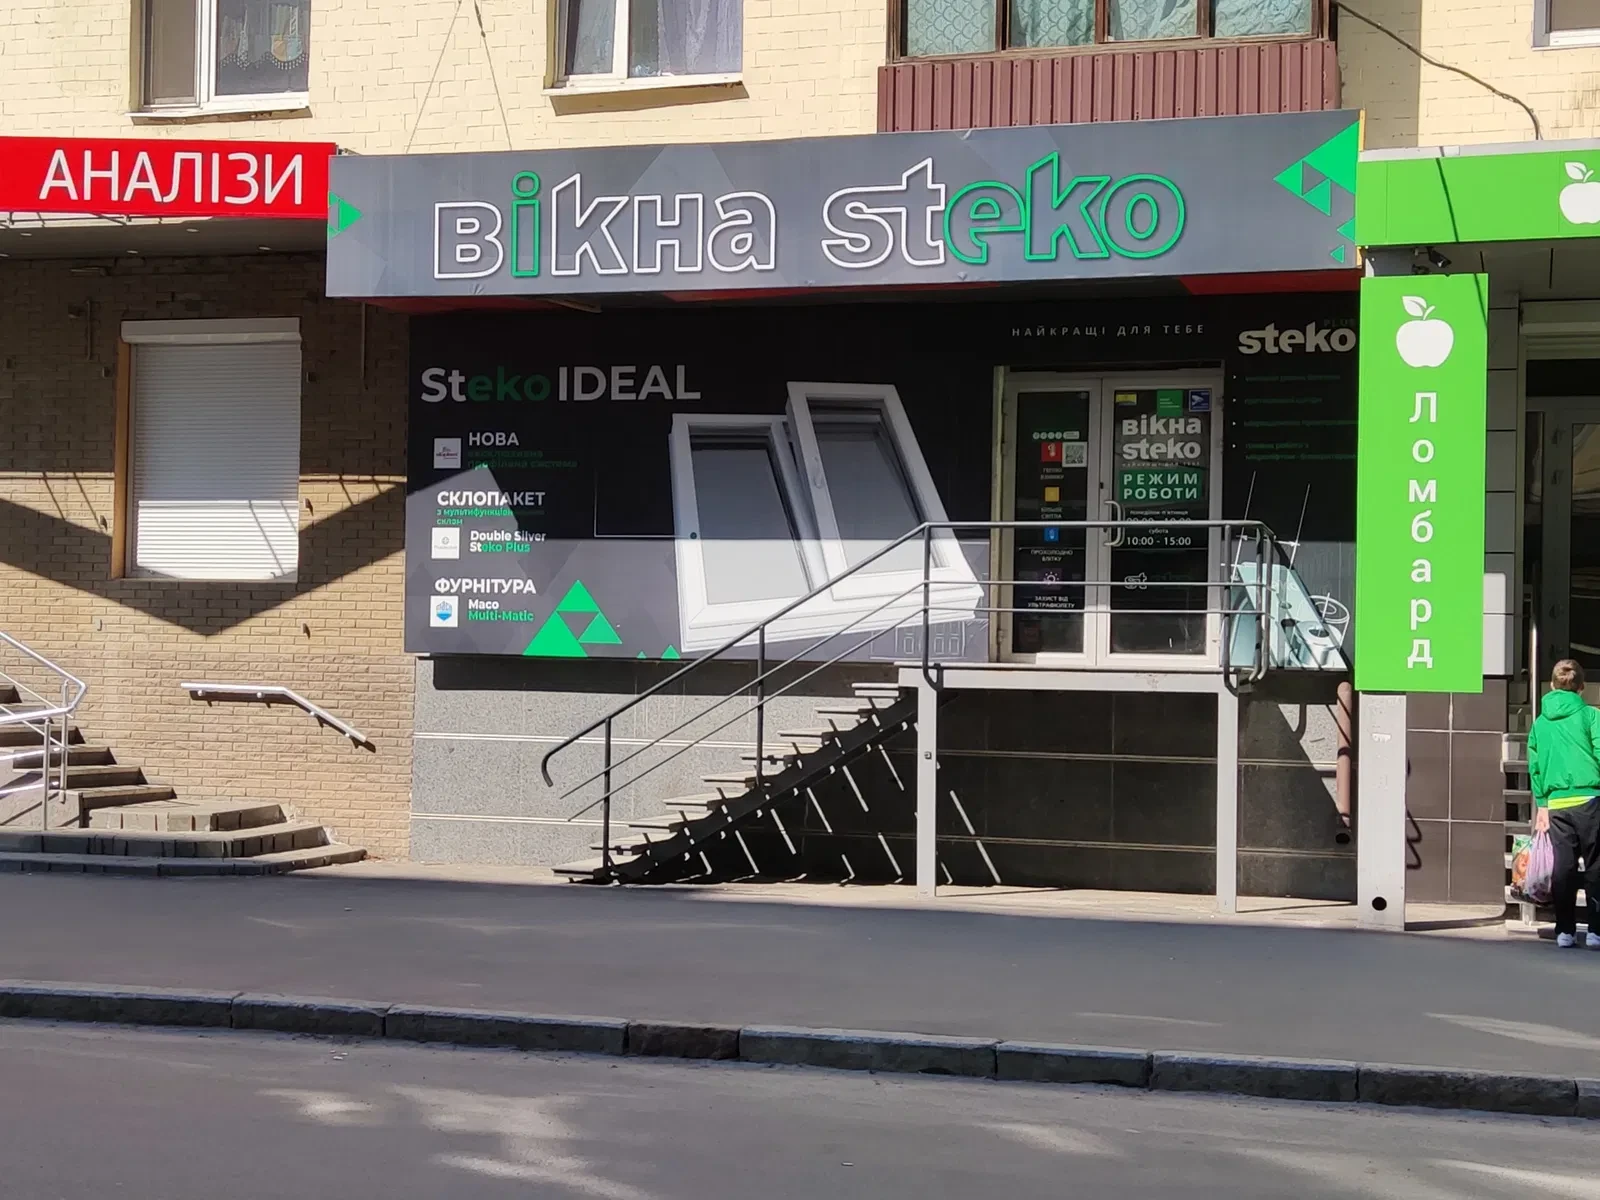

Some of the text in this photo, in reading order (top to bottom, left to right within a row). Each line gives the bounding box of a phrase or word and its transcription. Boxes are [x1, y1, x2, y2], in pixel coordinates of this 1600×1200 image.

[39, 149, 302, 205] АНАЛІЗИ
[822, 152, 1185, 268] steko
[1012, 324, 1204, 338] НАЙКРАЩІ ДЛЯ ТЕБЕ
[1237, 321, 1357, 354] steko
[421, 364, 702, 403] Steko IDEAL
[469, 432, 519, 447] НОВА
[1122, 437, 1201, 460] steko
[1123, 473, 1198, 485] РЕЖИМ
[437, 492, 546, 506] СКЛОПАКЕТ
[1123, 487, 1198, 499] РОБОТИ
[470, 530, 547, 542] Double Silver
[1407, 391, 1438, 669] Ломбард
[505, 541, 530, 553] Plus
[1127, 536, 1154, 546] 10:00
[1164, 536, 1191, 546] 15:00
[434, 578, 536, 594] ФУРНІТУРА
[468, 599, 499, 610] Maco
[468, 609, 534, 622] Multi-Matic
